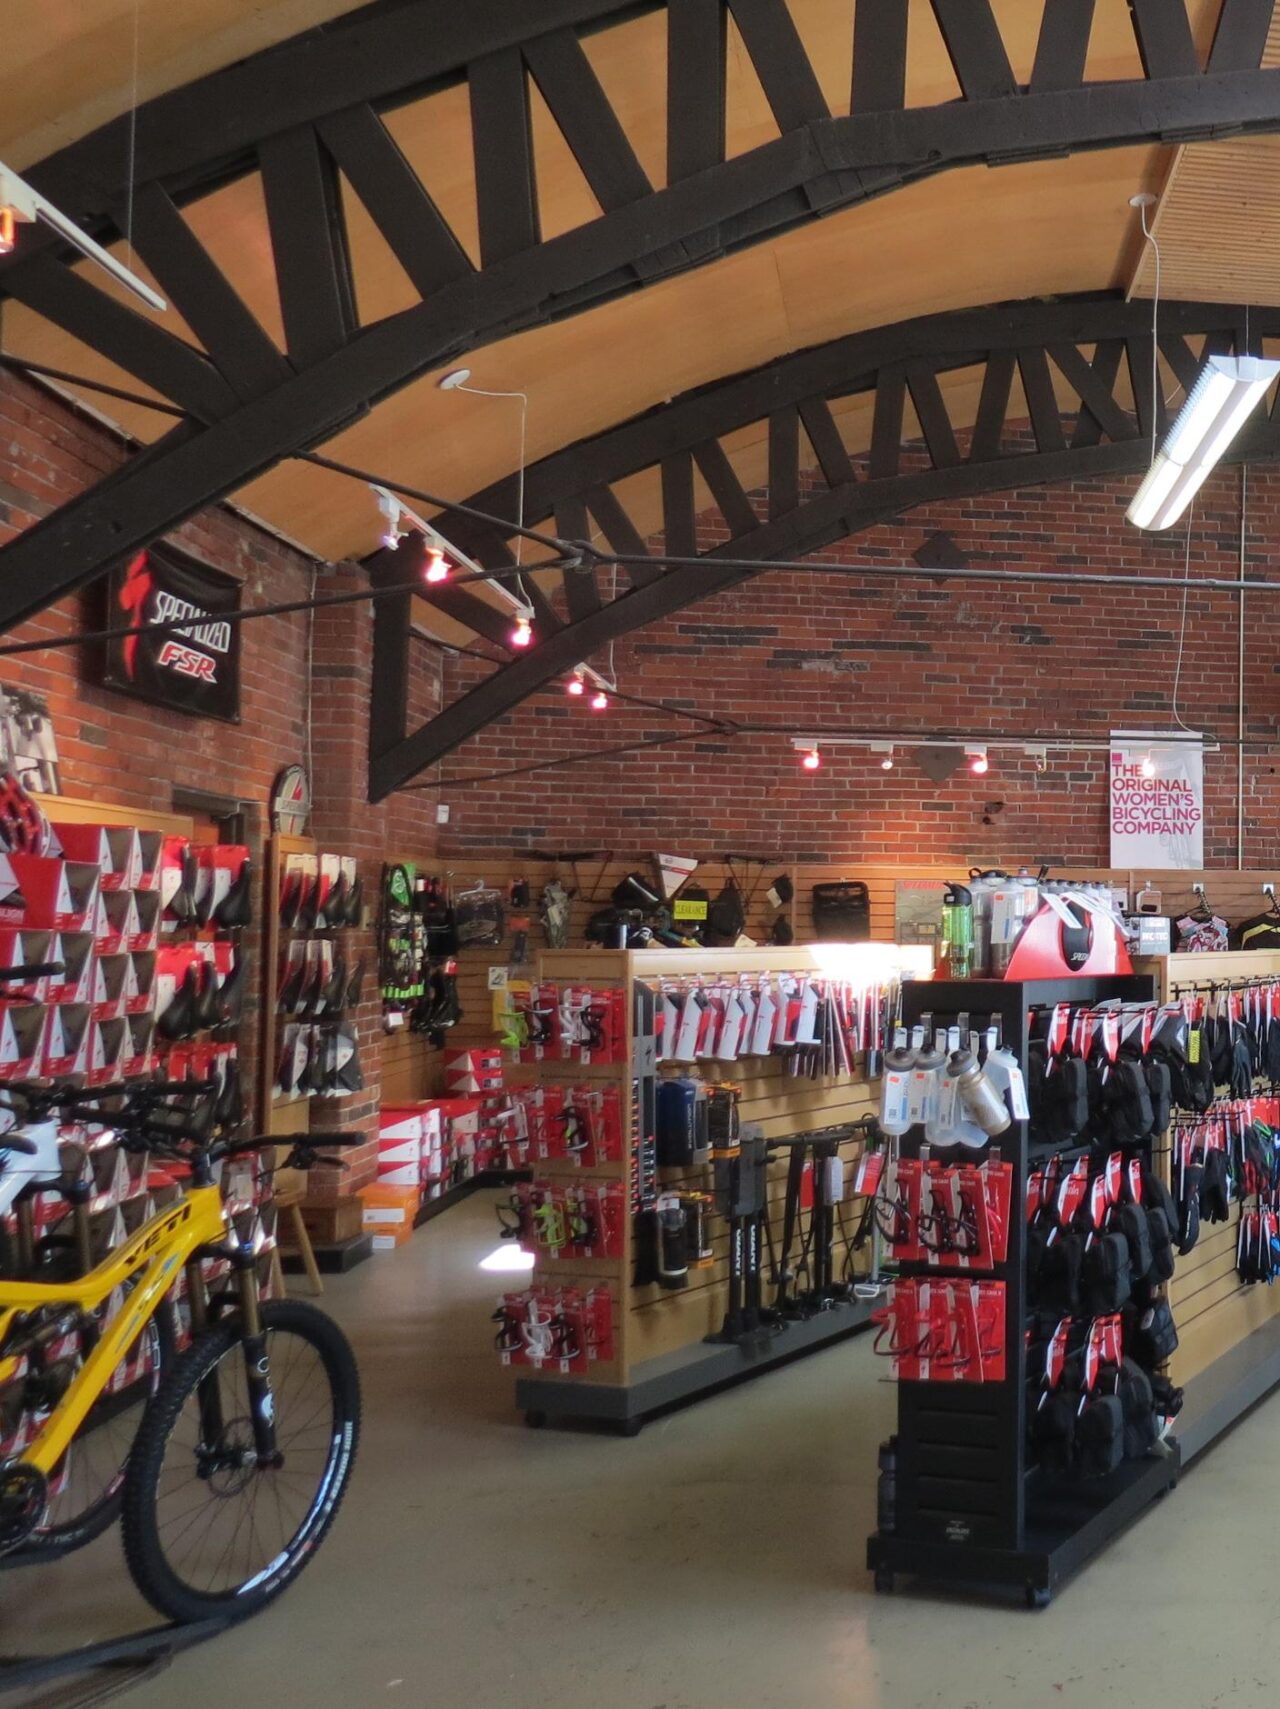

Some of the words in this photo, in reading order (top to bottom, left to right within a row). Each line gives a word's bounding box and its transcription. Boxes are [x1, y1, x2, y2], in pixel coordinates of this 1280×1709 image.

[158, 640, 218, 684] FSR
[1112, 764, 1143, 777] THE
[1112, 778, 1193, 792] ORIGINAL
[1112, 792, 1194, 806] WOMEN'S
[1112, 806, 1201, 821] BICYCLING
[1112, 820, 1196, 835] COMPANY
[123, 1203, 193, 1266] YETI
